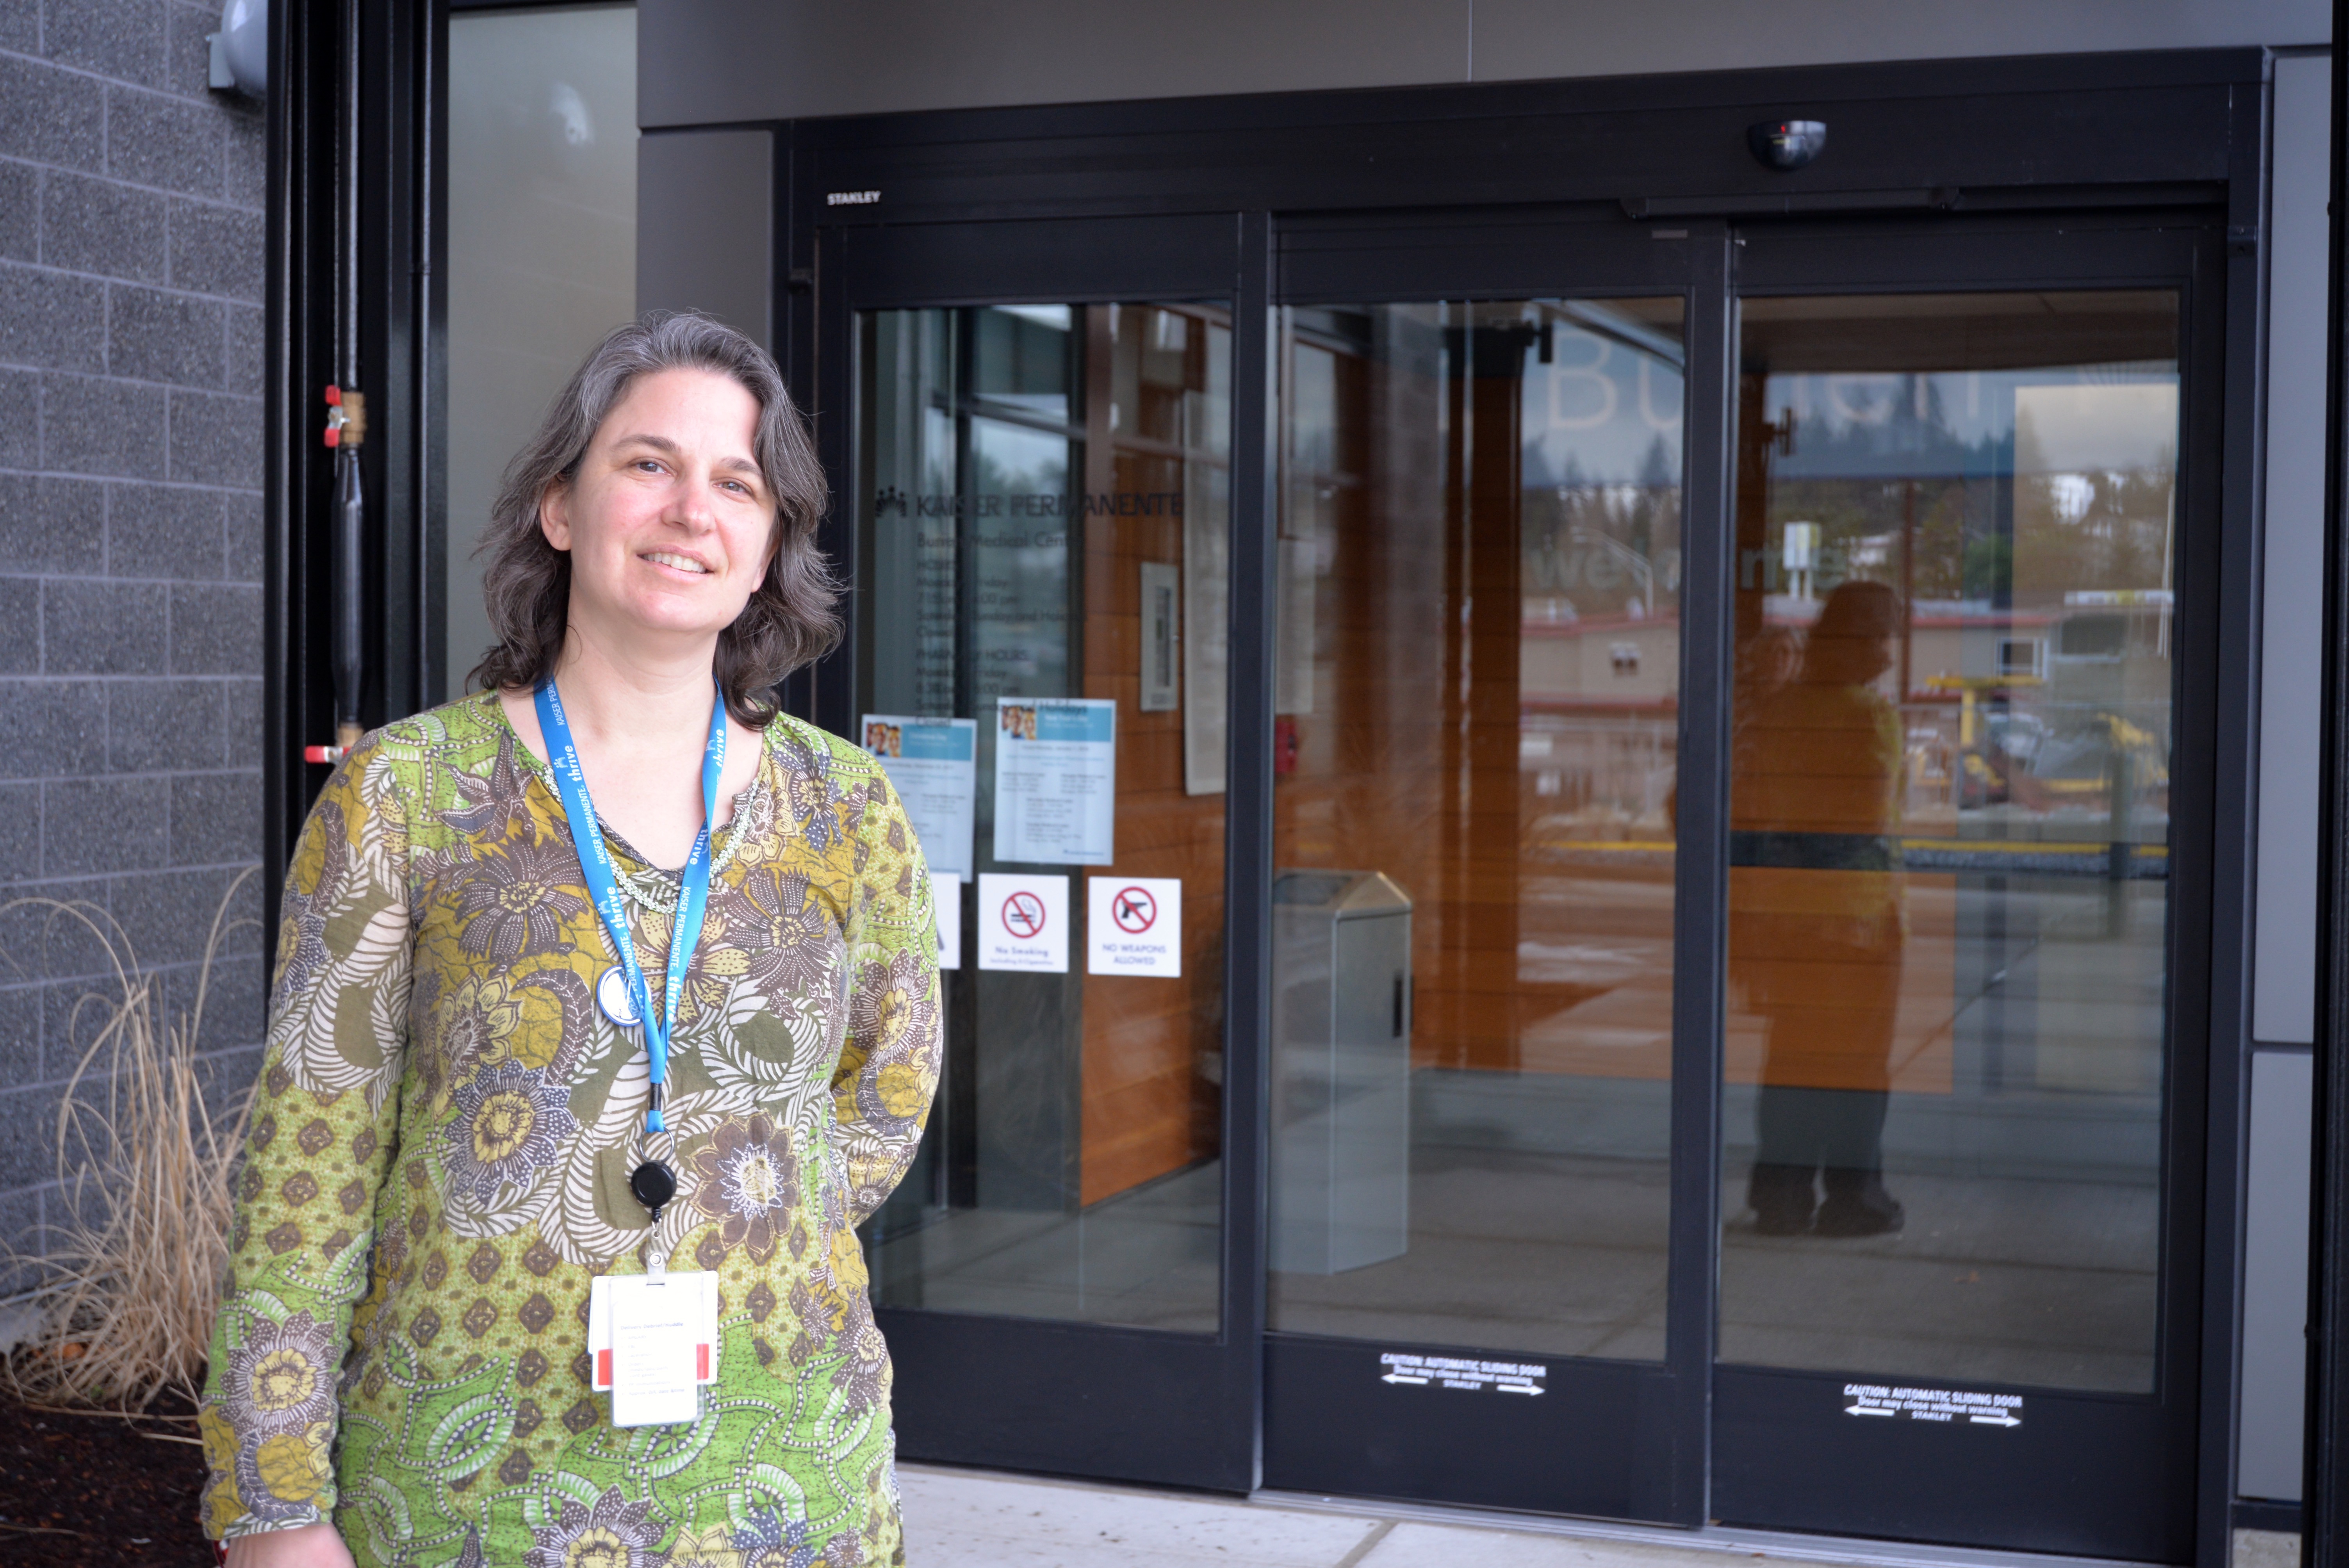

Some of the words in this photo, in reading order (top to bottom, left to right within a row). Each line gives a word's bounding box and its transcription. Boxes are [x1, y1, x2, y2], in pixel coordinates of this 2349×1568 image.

[827, 190, 881, 205] STANLEY
[551, 702, 566, 726] KAISER
[713, 729, 724, 768] thrive
[565, 745, 583, 782] thrive
[577, 787, 599, 837] PERMANENTE
[592, 839, 607, 864] KAISER
[690, 828, 708, 865] thrive
[607, 886, 626, 929] thrive
[679, 886, 691, 912] KAISER
[670, 914, 686, 968] PERMANENTE
[1012, 946, 1048, 958] Smoking
[1102, 943, 1117, 952] NO
[1120, 944, 1166, 954] WEAPONS
[1114, 955, 1156, 965] ALLOWED
[668, 976, 681, 1023] thrive
[1394, 1365, 1415, 1376] Door
[1415, 1367, 1435, 1379] may
[1425, 1357, 1480, 1372] AUTOMATIC
[1480, 1361, 1518, 1375] SLIDING
[1519, 1364, 1546, 1377] DOOR
[1443, 1379, 1482, 1390] STANLEY
[1858, 1396, 1881, 1407] Door
[1881, 1399, 1903, 1411] may
[1903, 1399, 1930, 1411] close
[1930, 1402, 1968, 1414] without
[1968, 1406, 2008, 1418] warning
[1891, 1387, 1951, 1404] AUTOMATIC
[1952, 1391, 1993, 1406] SLIDING
[1993, 1394, 2023, 1408] DOOR
[1911, 1410, 1952, 1422] STANLEY
